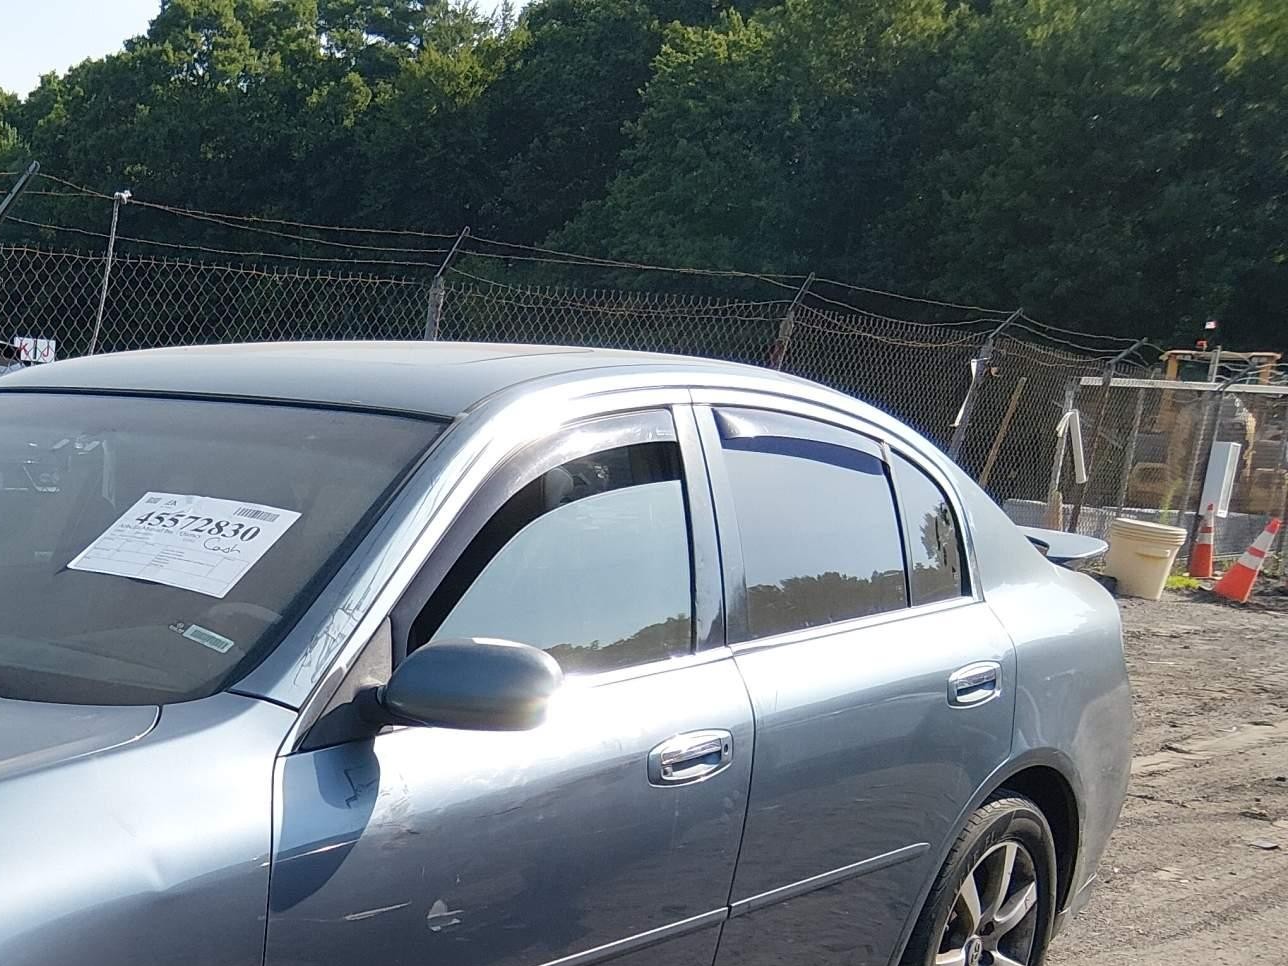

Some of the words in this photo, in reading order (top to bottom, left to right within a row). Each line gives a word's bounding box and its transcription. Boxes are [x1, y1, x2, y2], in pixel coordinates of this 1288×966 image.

[42, 341, 50, 357] J
[136, 511, 261, 542] 45572830
[203, 537, 241, 554] Cash
